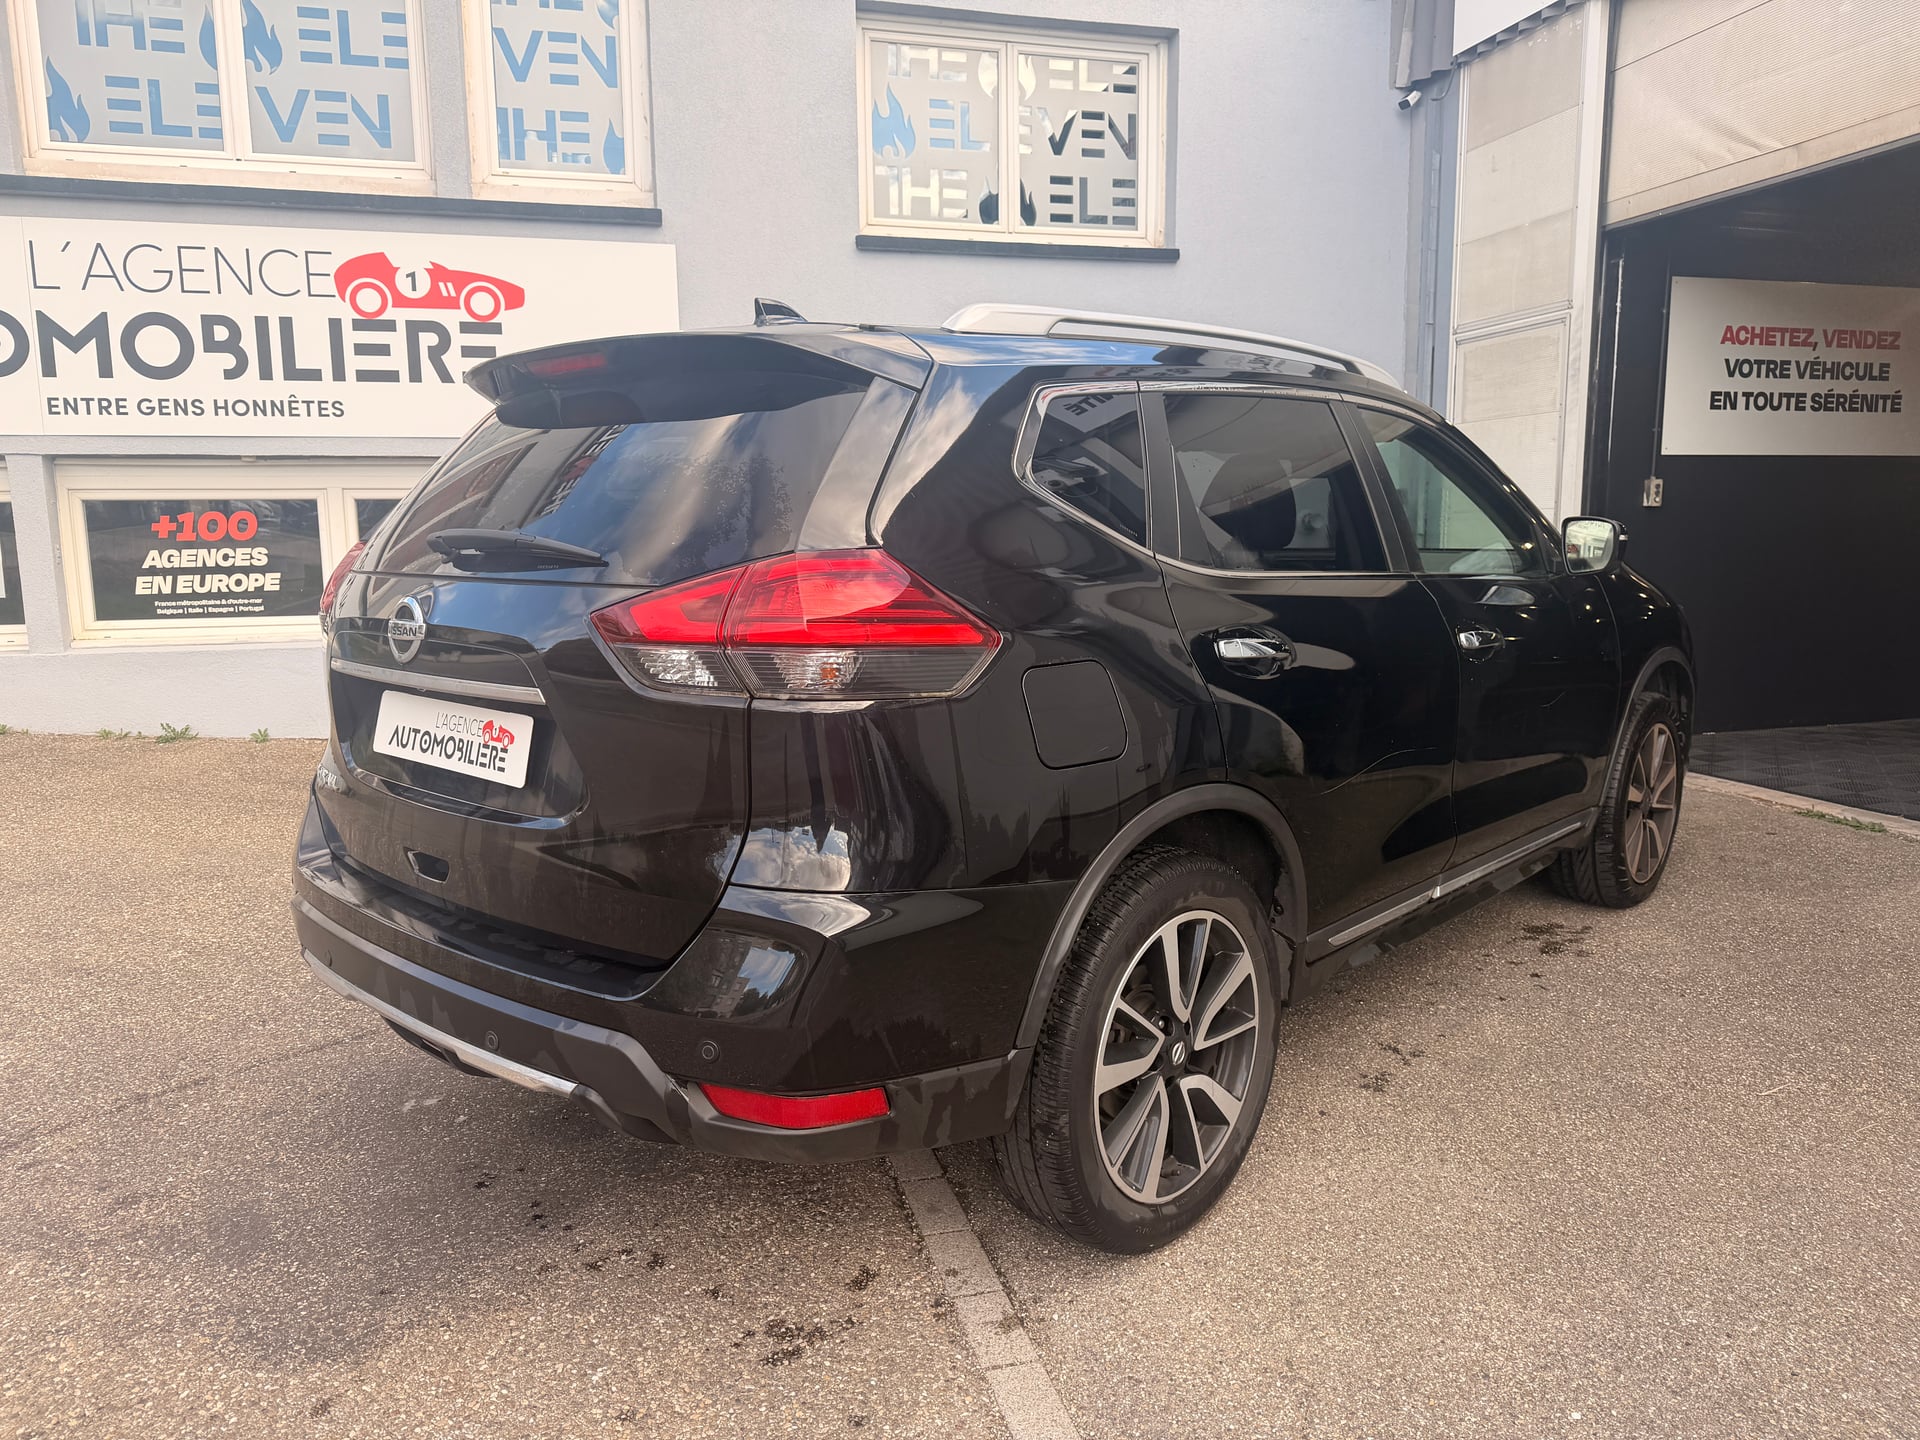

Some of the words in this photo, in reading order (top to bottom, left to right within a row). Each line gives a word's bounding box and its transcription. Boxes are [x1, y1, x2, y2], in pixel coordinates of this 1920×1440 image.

[492, 27, 619, 89] VEN
[875, 165, 968, 219] THE
[1050, 175, 1136, 227] ELE
[28, 239, 337, 298] L'AGENCE
[405, 271, 417, 292] 1
[1720, 325, 1819, 351] ACHETEZ,
[1822, 329, 1902, 350] VENDEZ
[1724, 358, 1792, 379] VOTRE
[1795, 356, 1890, 381] VÉHICULE
[46, 396, 129, 416] ENTRE
[136, 397, 205, 417] GENS
[213, 394, 345, 418] HONNÊTES
[1709, 391, 1738, 411] EN
[1742, 391, 1808, 411] TOUTE
[1810, 388, 1903, 413] SÉRÉNITÉ
[151, 510, 258, 542] +100
[142, 547, 269, 569] AGENCES
[135, 575, 173, 596] EN
[176, 572, 281, 595] EUROPE
[435, 712, 484, 738] L'AGENCE
[388, 724, 509, 773] AUTOMOBILIERE
